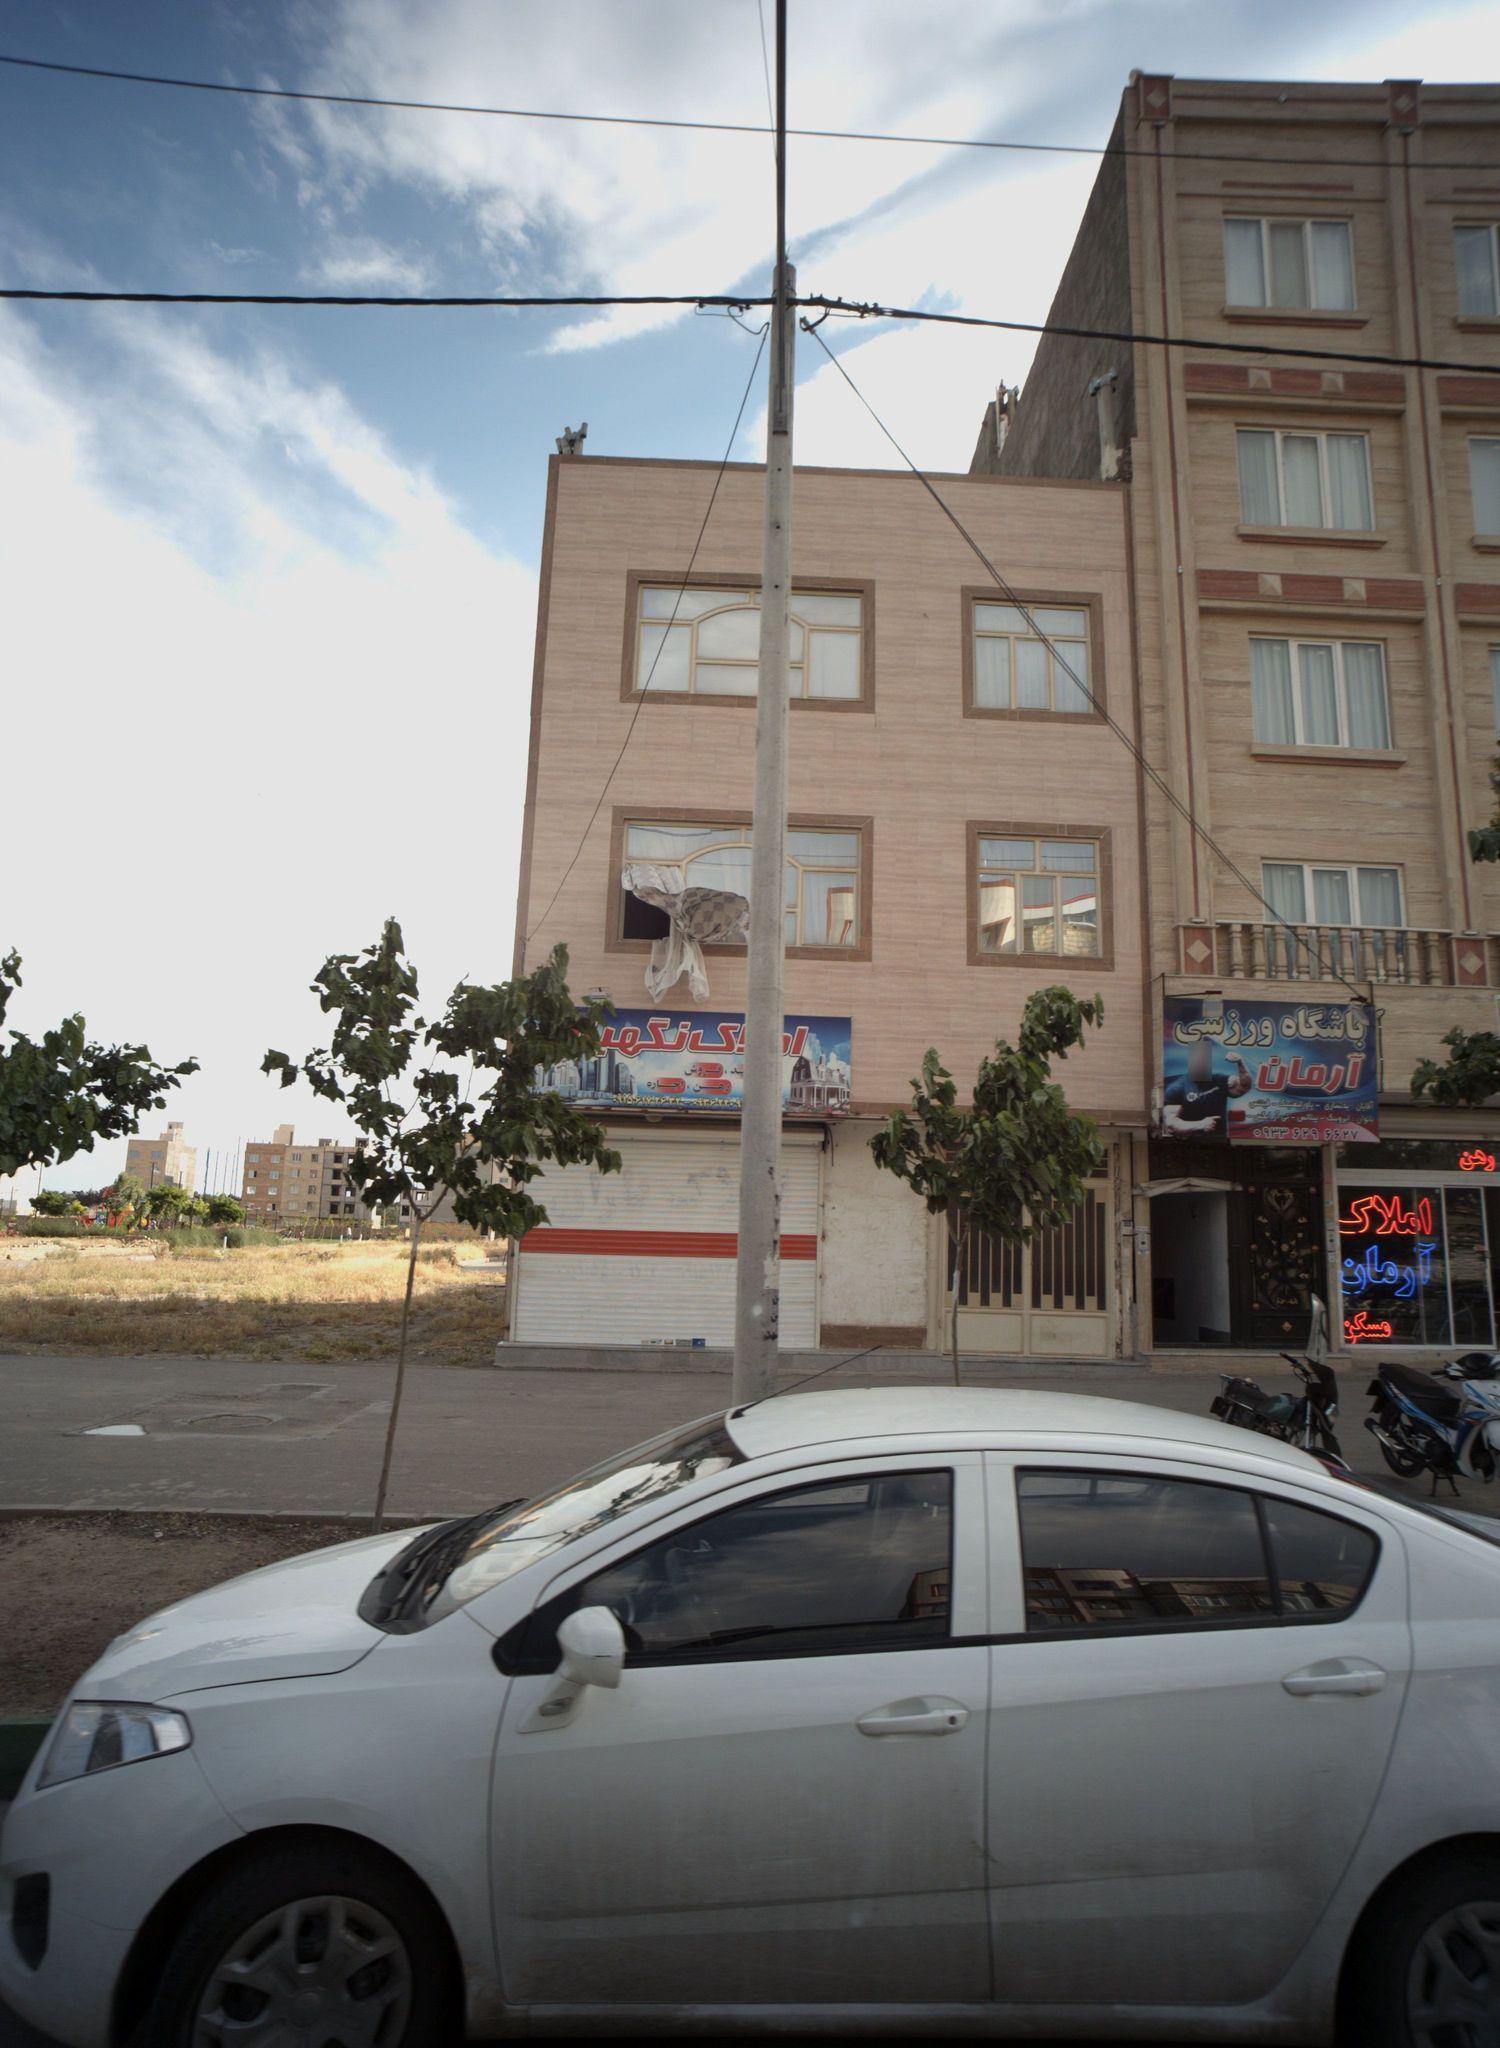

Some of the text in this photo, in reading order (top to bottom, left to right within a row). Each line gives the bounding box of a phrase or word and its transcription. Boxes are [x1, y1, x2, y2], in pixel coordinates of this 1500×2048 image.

[1280, 1007, 1368, 1049] باشگاه
[1256, 1053, 1366, 1094] آرمان
[1252, 1127, 1289, 1139] ۰۹۳۳
[1459, 1149, 1496, 1172] رهن
[1338, 1195, 1433, 1235] املاک
[1339, 1243, 1437, 1297] آرمان
[1343, 1311, 1393, 1344] مسکن
